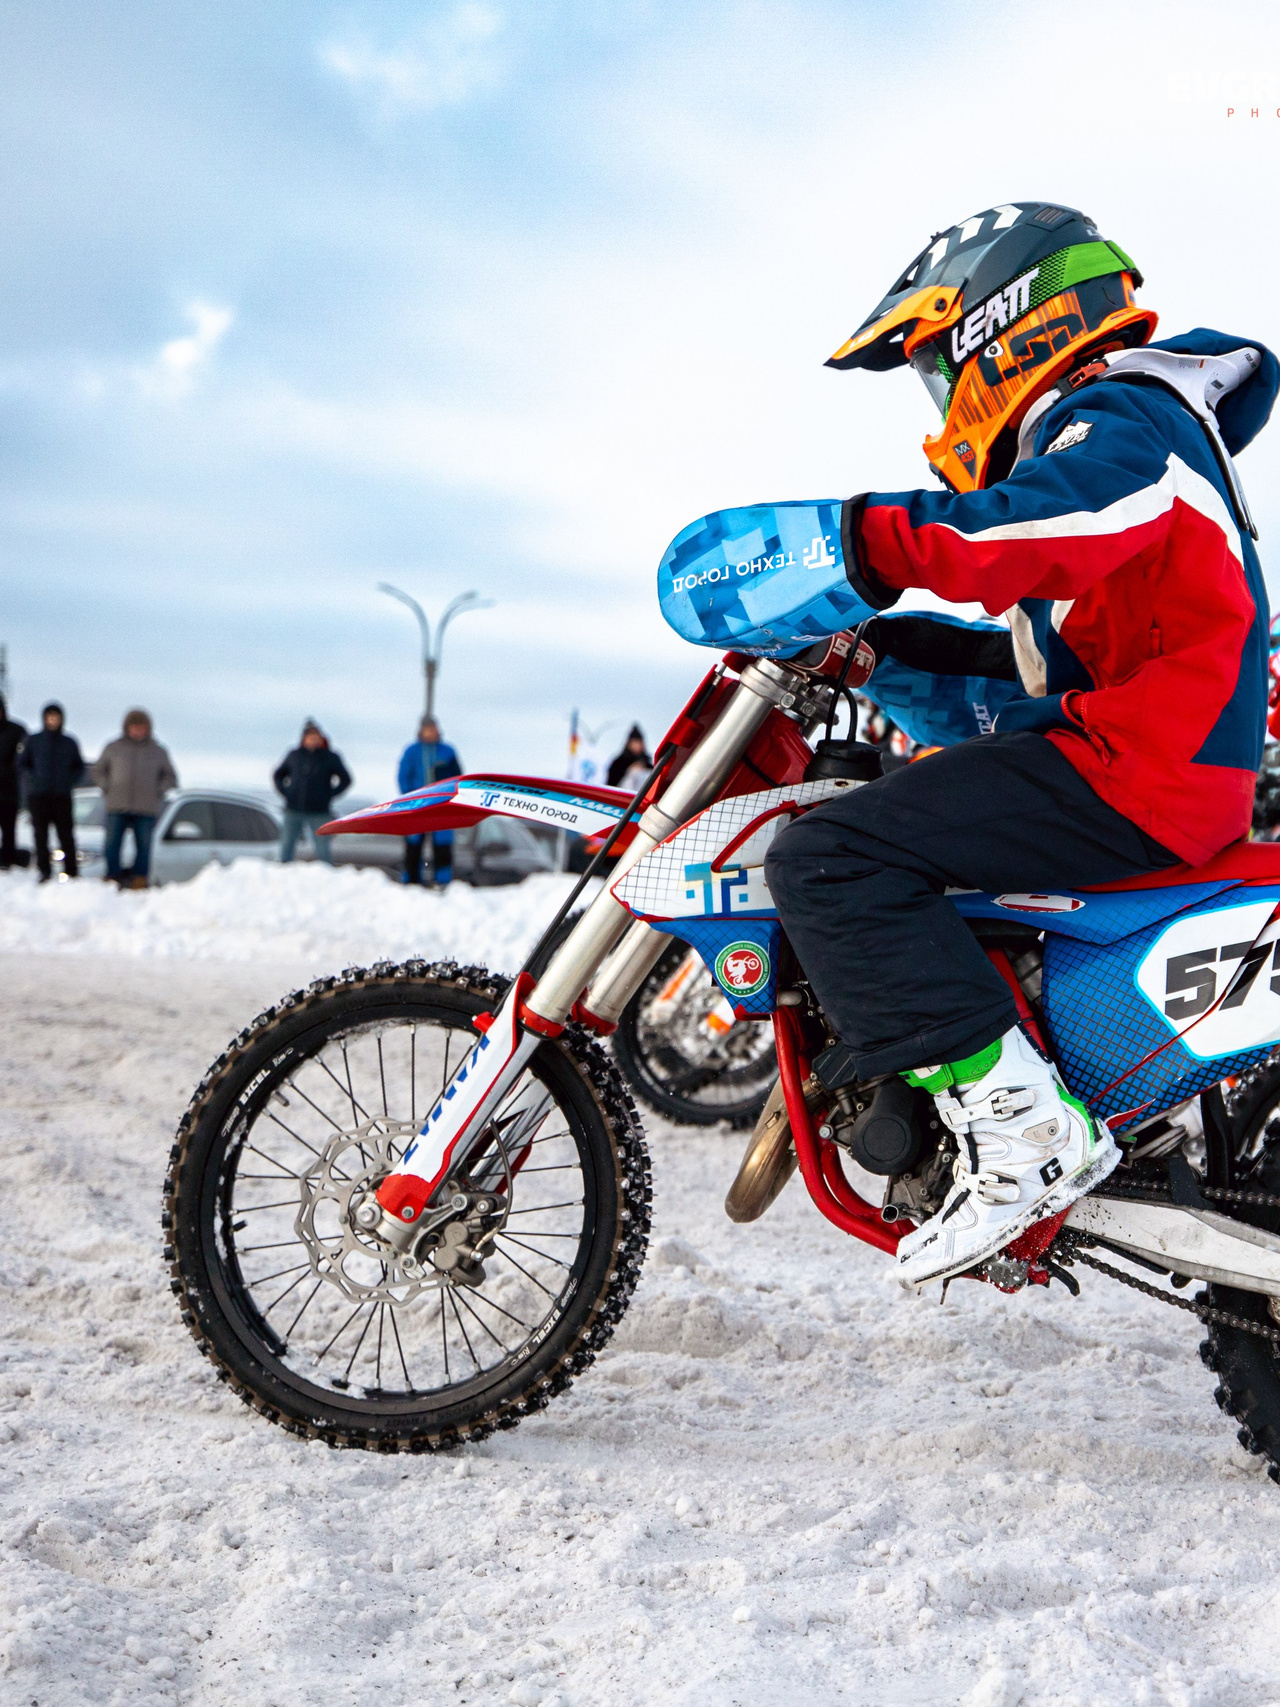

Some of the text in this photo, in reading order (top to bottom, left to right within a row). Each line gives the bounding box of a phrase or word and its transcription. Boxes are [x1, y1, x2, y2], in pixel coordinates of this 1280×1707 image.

[952, 267, 1040, 363] LEATT
[736, 551, 796, 576] ТЕХНО
[503, 797, 578, 823] ТЕХНО ГОРОД
